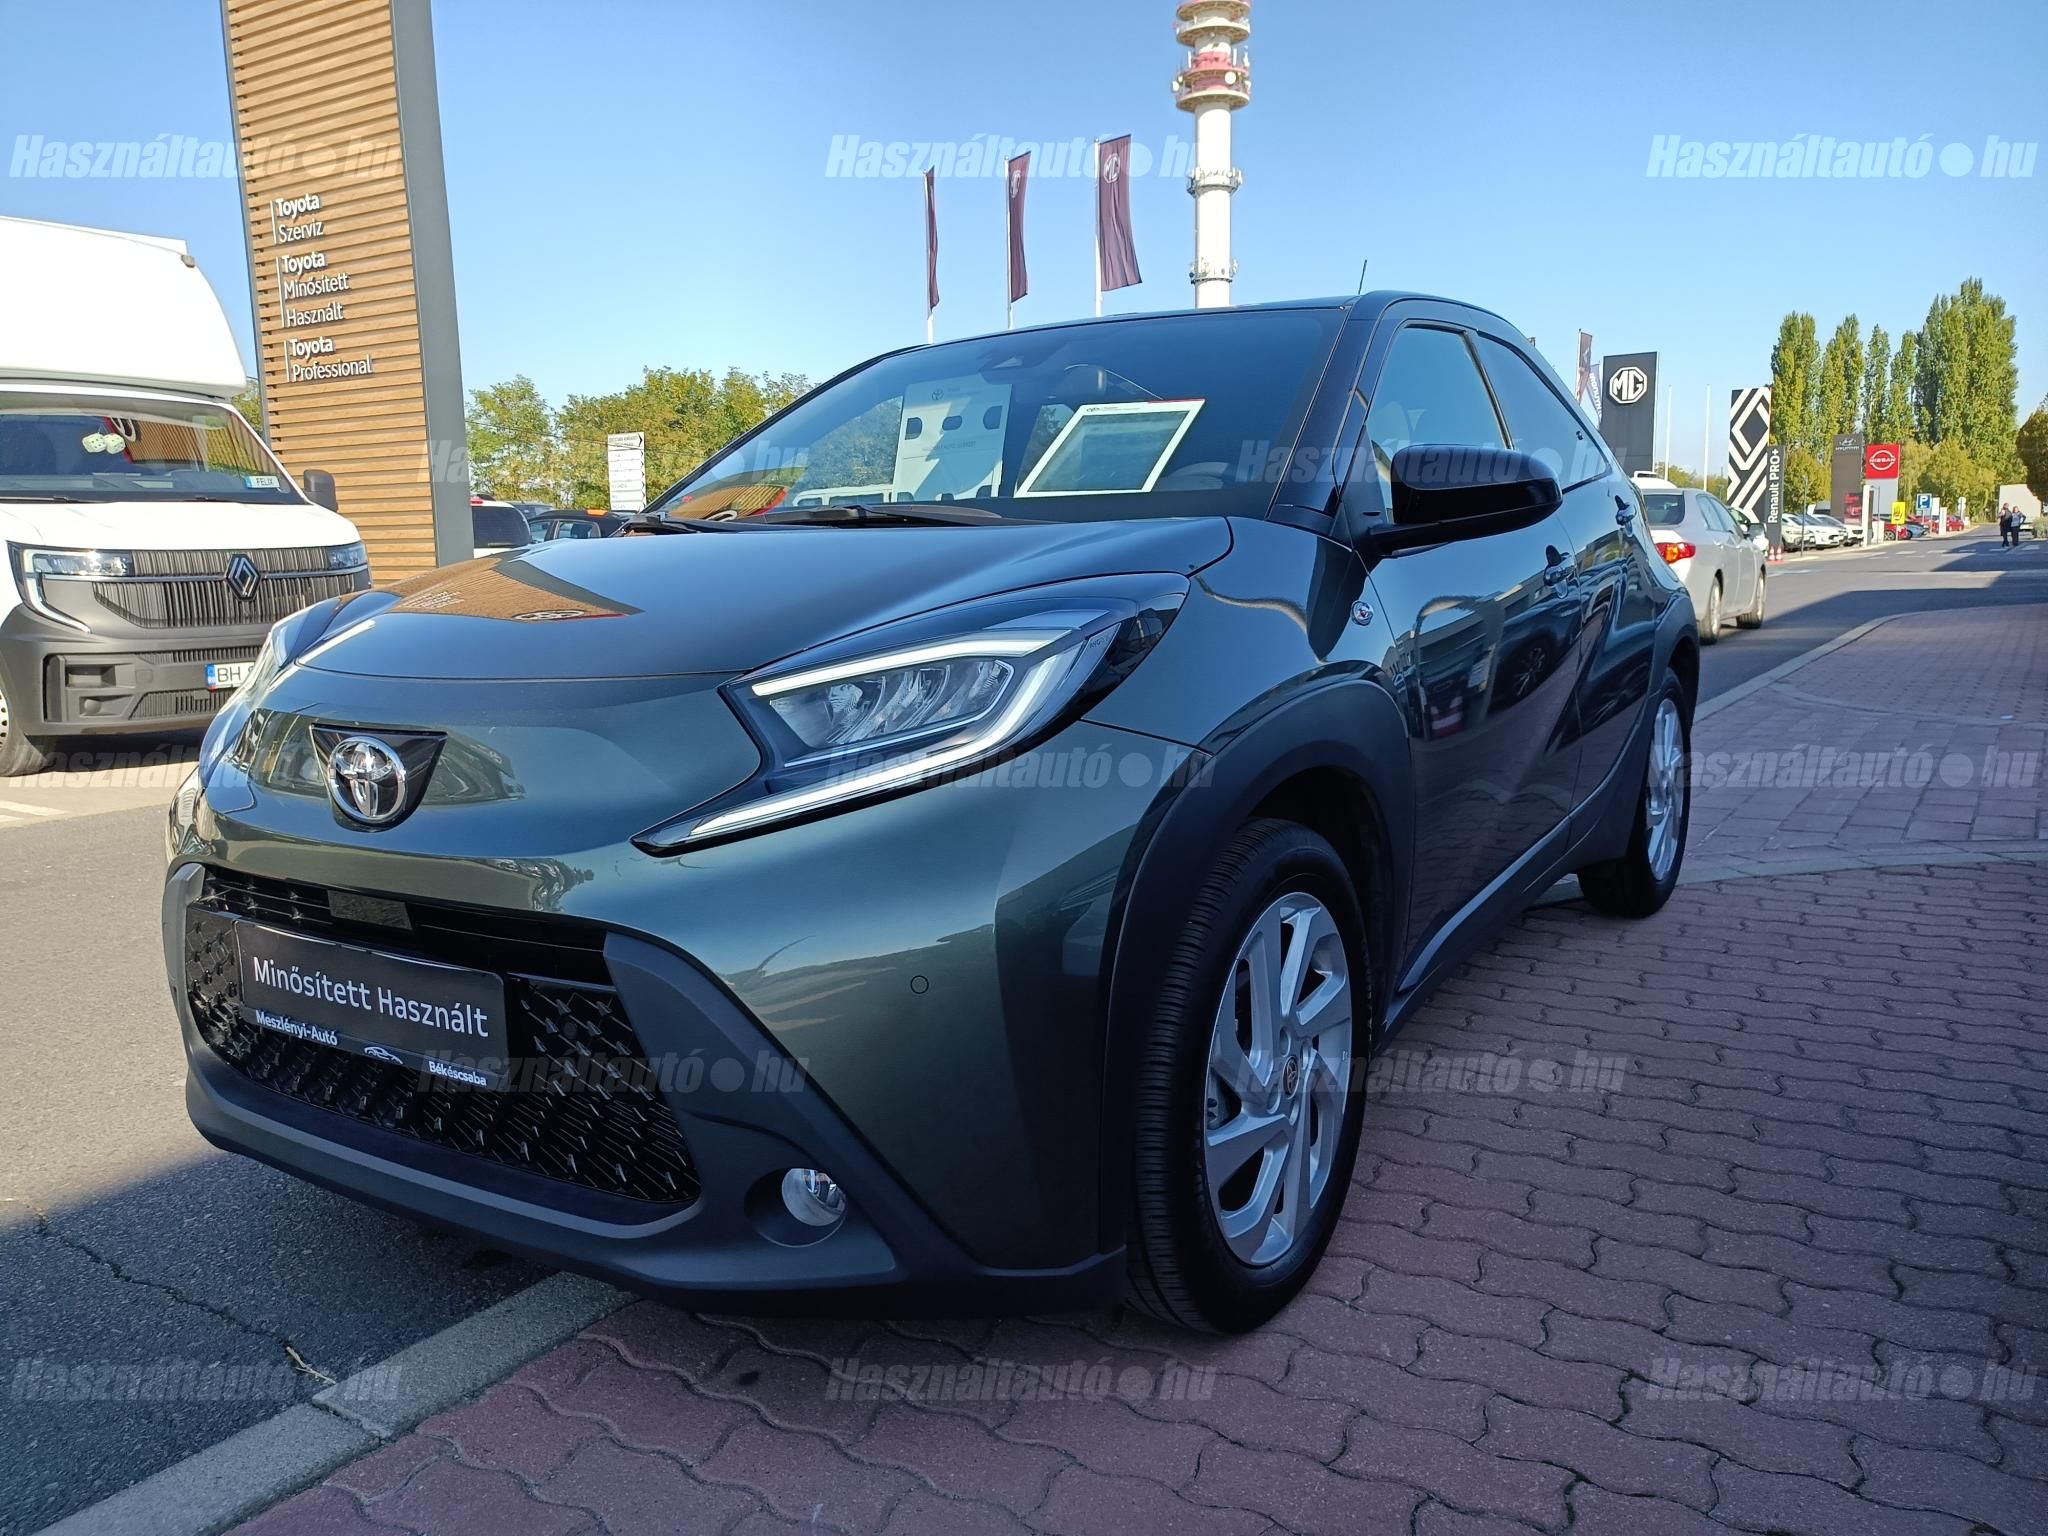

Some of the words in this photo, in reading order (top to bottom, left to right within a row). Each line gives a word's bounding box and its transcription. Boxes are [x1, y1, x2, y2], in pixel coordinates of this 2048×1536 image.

[276, 193, 320, 218] Toyota
[279, 219, 324, 243] Szerviz
[282, 251, 326, 275] Toyota
[284, 272, 349, 300] Minősített
[286, 302, 344, 327] Használt
[290, 336, 333, 359] Toyota
[293, 354, 372, 382] Professional
[1612, 369, 1646, 402] MG
[1769, 449, 1780, 480] PRO+
[1768, 482, 1779, 523] Renault
[253, 956, 372, 1011] Minősített
[377, 986, 489, 1038] Használt
[256, 1009, 338, 1047] Meszlényi-Autó
[429, 1060, 488, 1087] Békéscsaba
